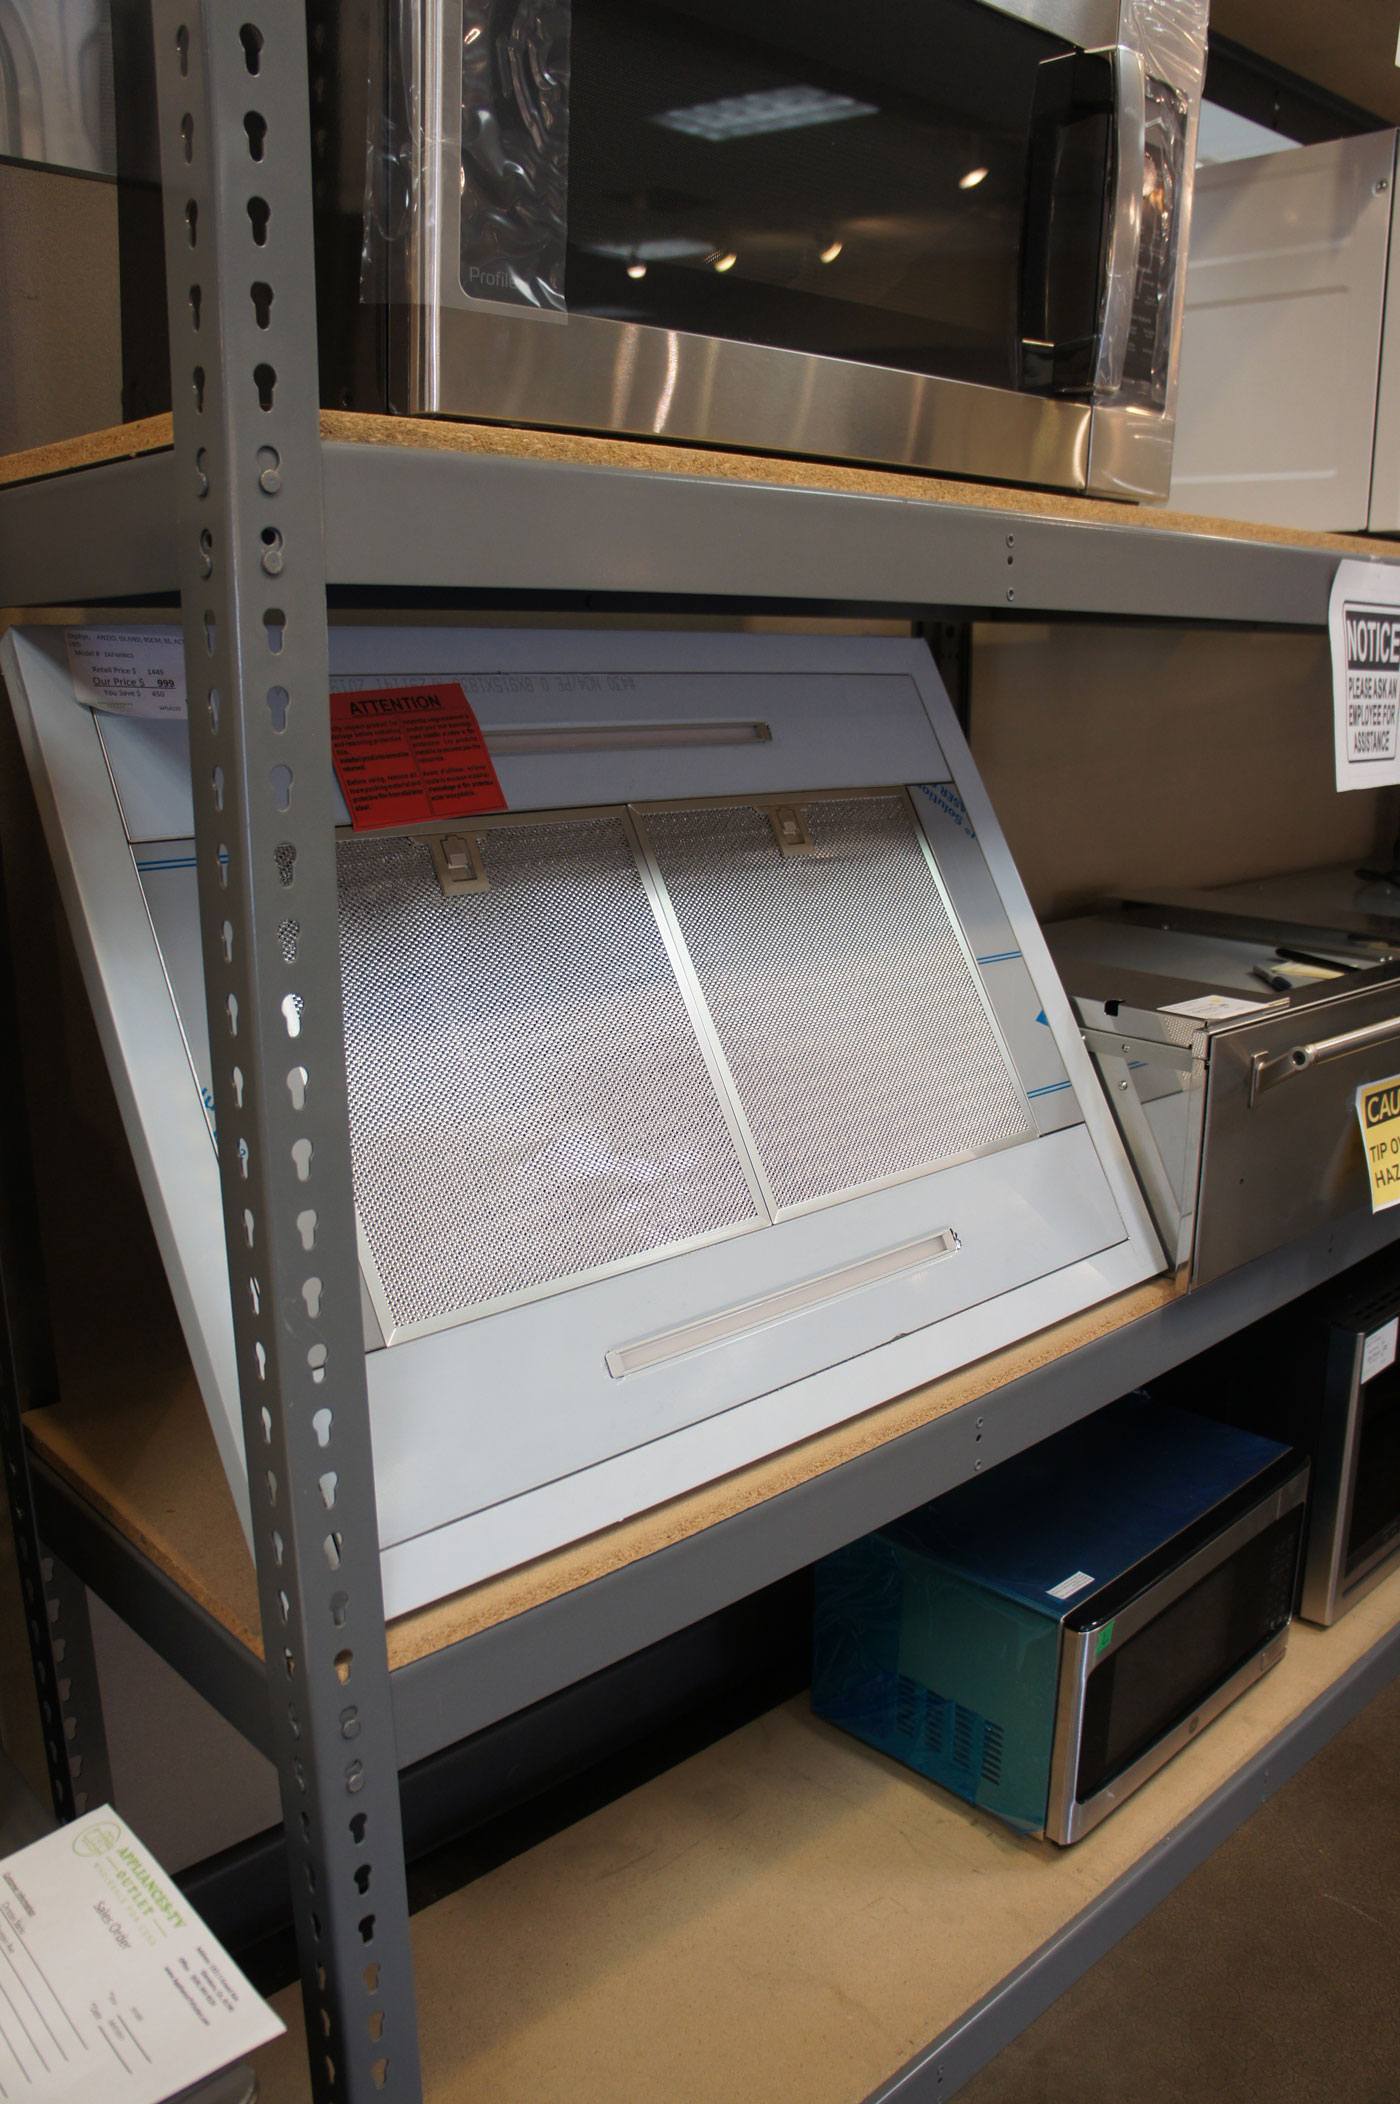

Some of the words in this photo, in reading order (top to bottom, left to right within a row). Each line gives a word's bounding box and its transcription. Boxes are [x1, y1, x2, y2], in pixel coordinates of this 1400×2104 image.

[1347, 620, 1400, 663] NOTICE
[93, 677, 110, 686] Our
[114, 677, 137, 687] Price
[139, 678, 145, 688] $
[157, 679, 175, 688] 999
[132, 667, 136, 675] $
[1349, 677, 1372, 700] PLEASE
[1373, 678, 1387, 700] ASK
[1388, 679, 1398, 700] AN
[350, 694, 441, 715] ATTENTION
[1349, 704, 1382, 727] EMPLOYEE
[1383, 705, 1396, 726] FOR
[1354, 731, 1390, 753] ASSISTANCE
[1370, 1142, 1388, 1163] TIP
[116, 1870, 153, 1915] OUTLET
[117, 1847, 187, 1928] APPLIANCES-TV
[93, 1900, 112, 1925] Sales
[108, 1922, 131, 1950] Order
